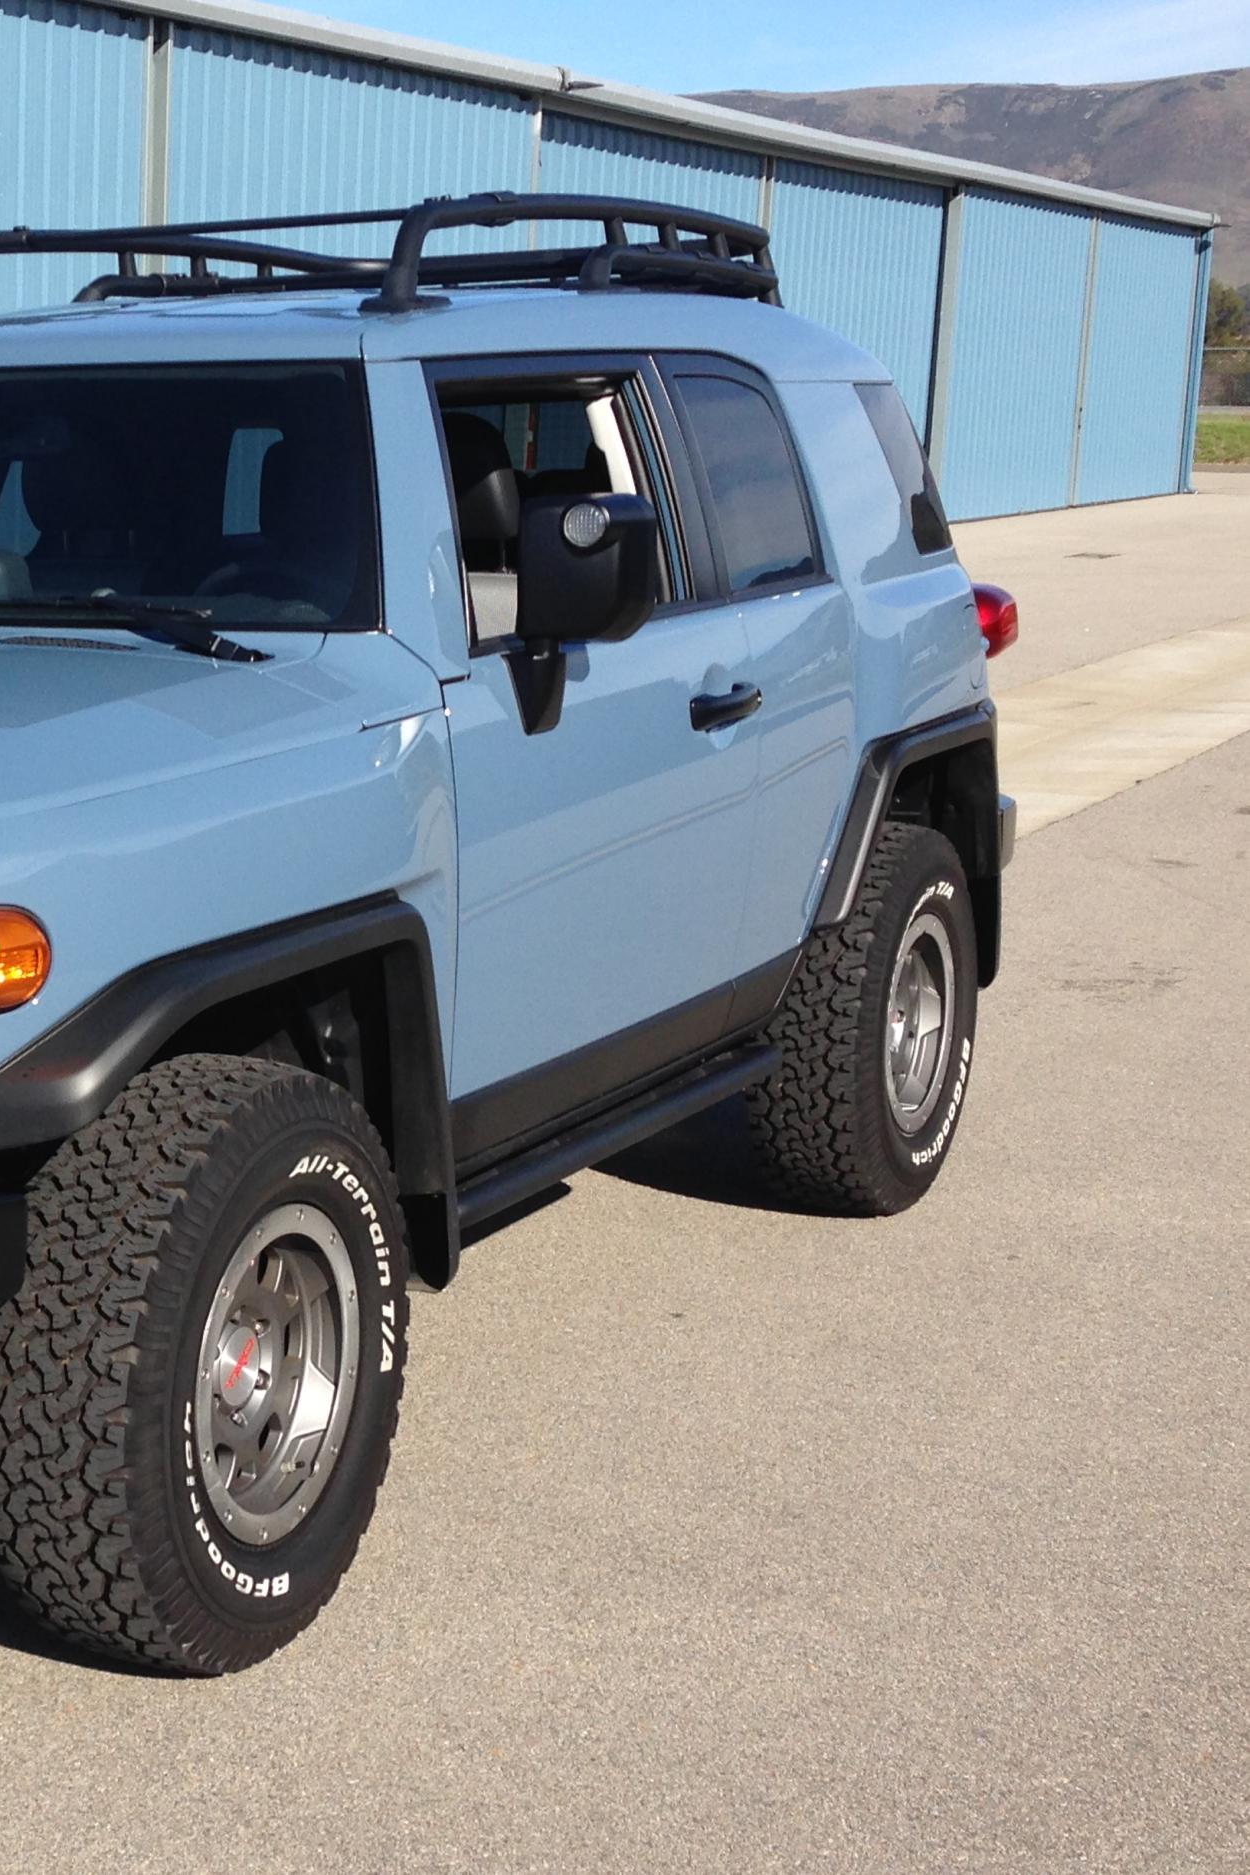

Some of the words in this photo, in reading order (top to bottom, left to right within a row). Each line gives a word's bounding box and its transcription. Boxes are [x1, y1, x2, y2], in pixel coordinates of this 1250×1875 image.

[936, 881, 955, 900] T/A
[911, 1037, 971, 1166] BFGoodrich
[288, 1154, 392, 1287] All-Terrain
[379, 1299, 396, 1374] T/A
[183, 1400, 291, 1598] BFGoodrich
